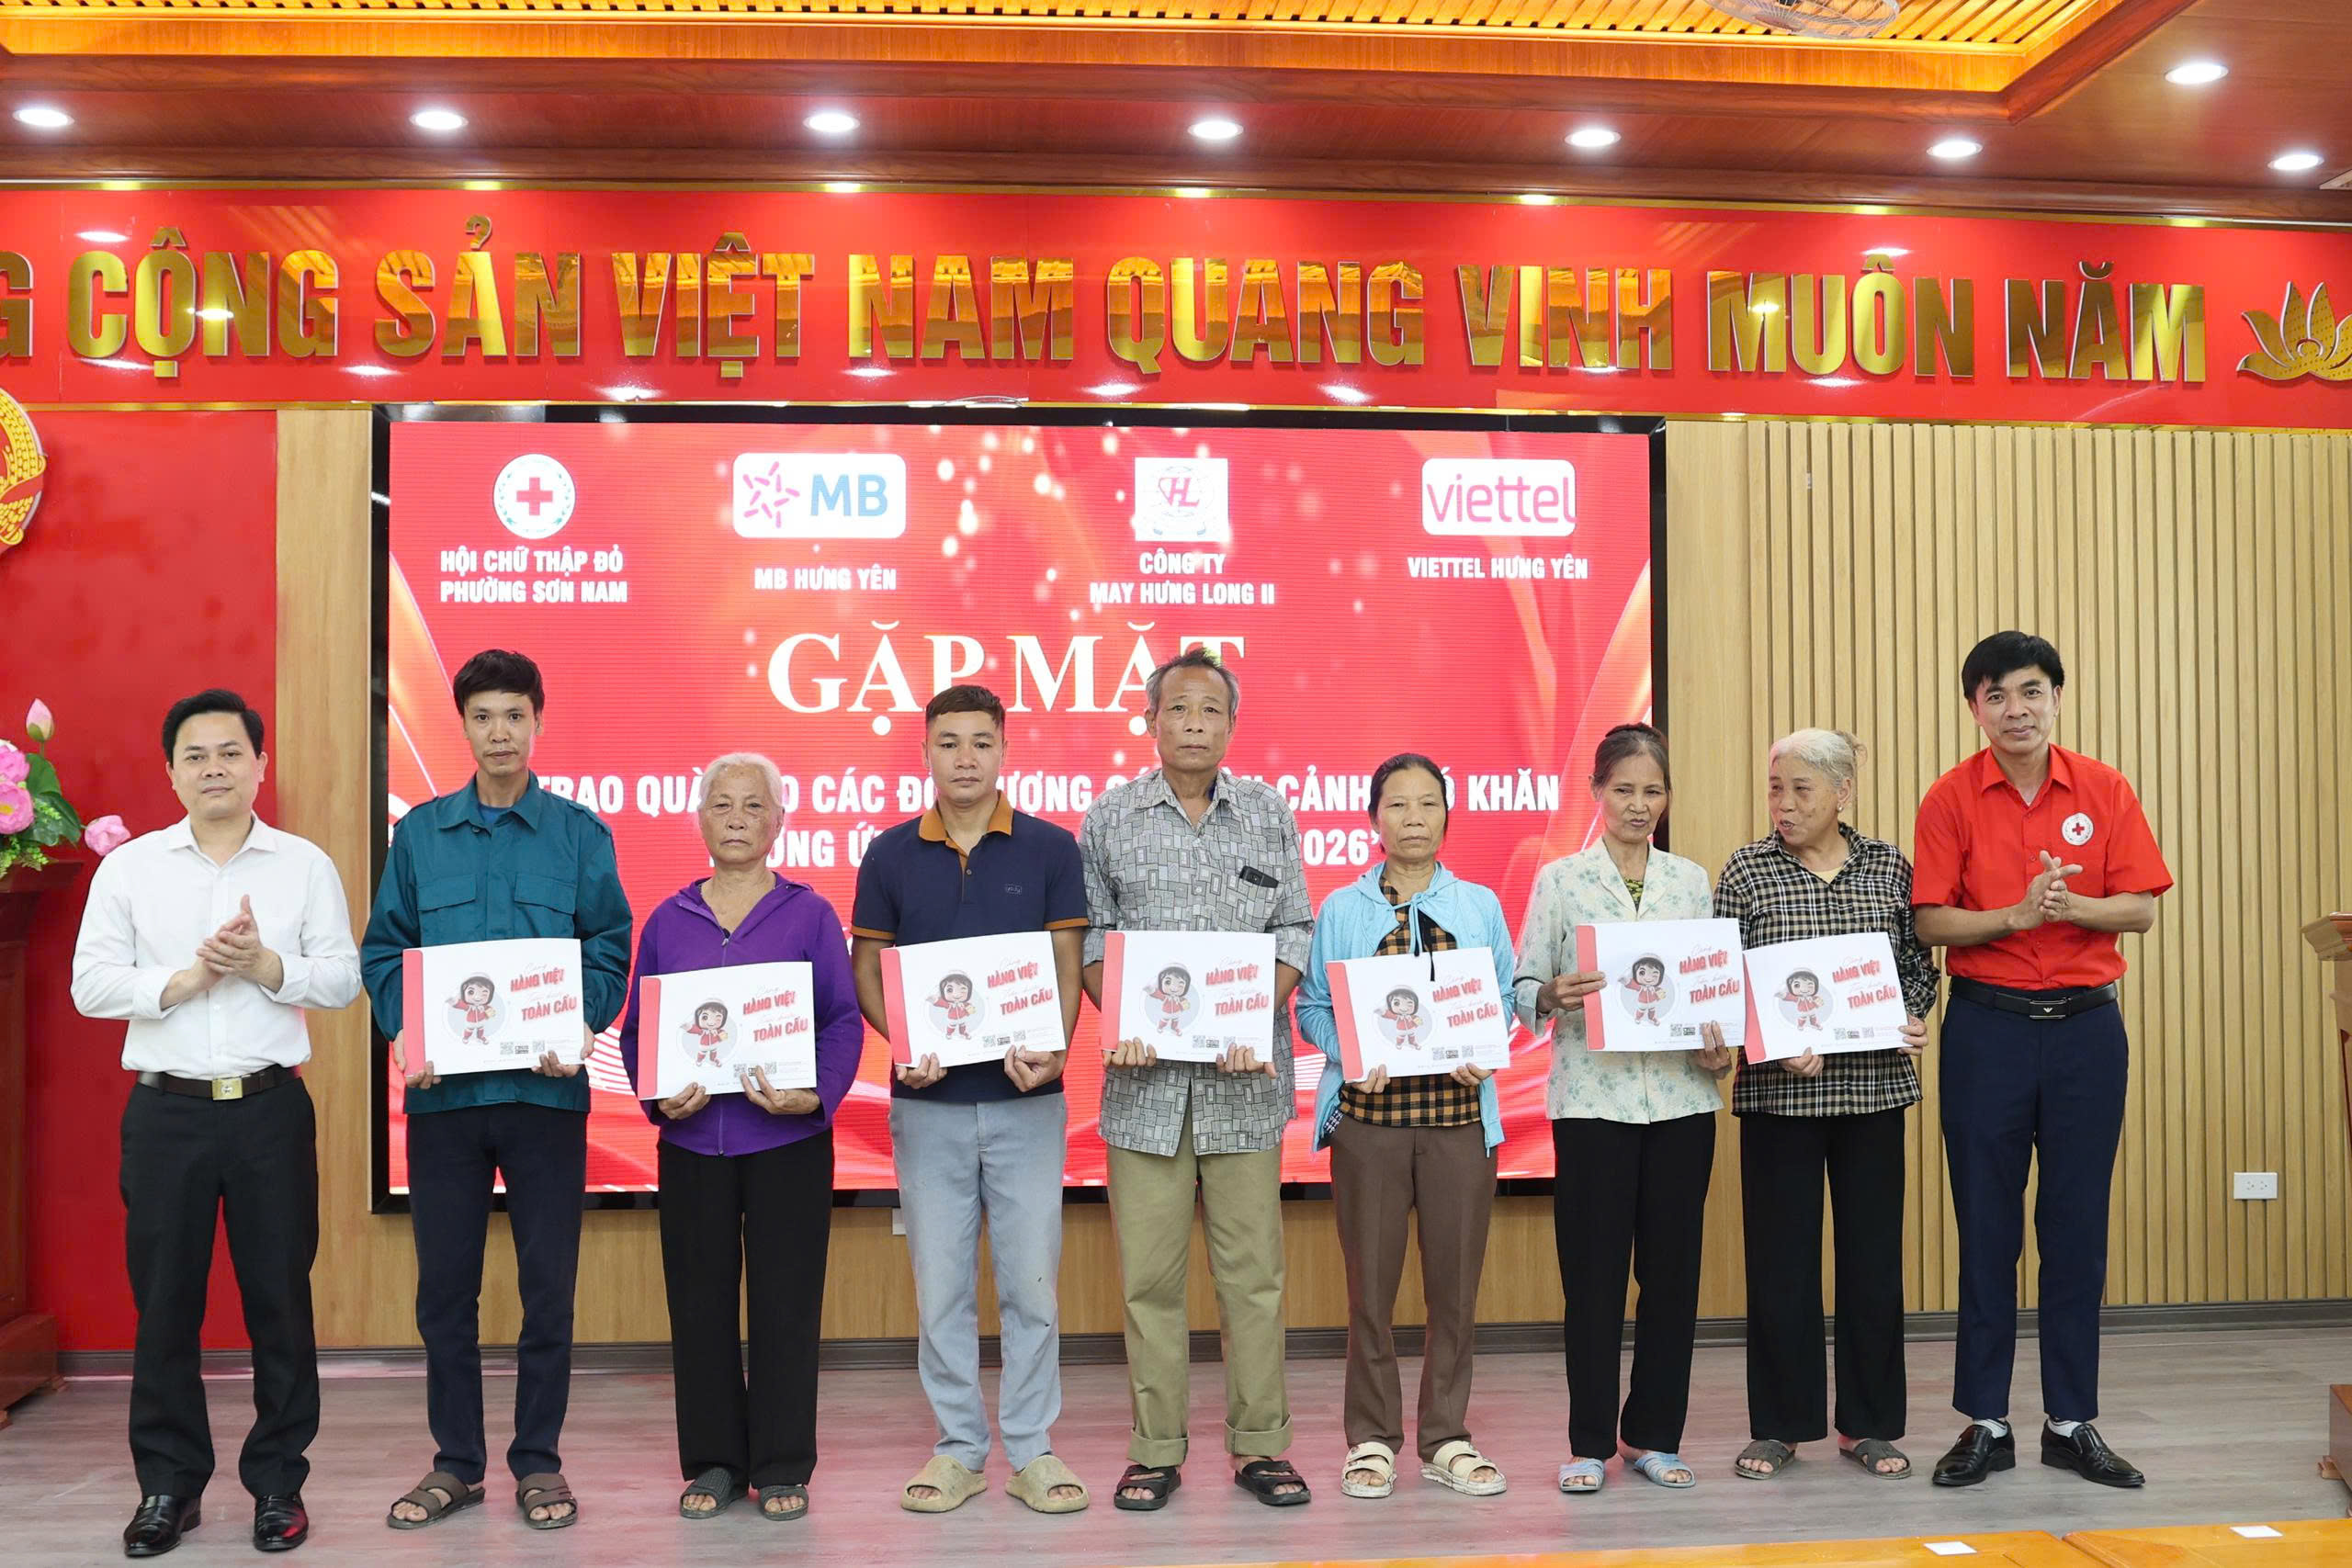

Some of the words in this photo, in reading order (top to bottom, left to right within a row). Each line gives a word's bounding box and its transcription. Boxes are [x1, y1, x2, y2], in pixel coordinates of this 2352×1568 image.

[67, 227, 339, 378] CỘNG
[375, 215, 581, 358] SẢN
[612, 231, 815, 378] VIỆT
[849, 254, 1073, 359] NAM
[1107, 257, 1424, 373] QUANG
[1458, 264, 1672, 372] VINH
[1707, 254, 1973, 378] MUÔN
[2005, 262, 2205, 382] NĂM
[811, 474, 888, 516] MB
[1427, 473, 1577, 524] viettel
[441, 546, 477, 577] HỘI
[483, 546, 529, 572] CHỮ
[534, 546, 588, 577] THẬP
[594, 544, 624, 572] ĐỎ
[1139, 547, 1196, 574] CÔNG
[1202, 553, 1227, 574] TY
[1407, 557, 1486, 579] VIETTEL
[1491, 555, 1545, 579] HƯNG
[1550, 553, 1589, 580] YÊN
[440, 576, 526, 603] PHƯỜNG
[532, 578, 574, 603] SƠN
[581, 581, 628, 603] NAM
[754, 568, 788, 591] MB
[794, 565, 852, 591] HƯNG
[857, 563, 897, 591] YÊN
[1090, 582, 1135, 604] MAY
[1140, 580, 1196, 604] HƯNG
[1202, 582, 1255, 604] LONG
[768, 621, 985, 736] GẶP
[811, 767, 885, 813] CÁC
[1275, 765, 1372, 812] CẢNH
[1468, 768, 1559, 811] KHĂN
[1000, 997, 1028, 1015] TOÀN
[1690, 983, 1716, 1003] TOÀN
[1847, 991, 1874, 1010] TOÀN
[522, 1002, 550, 1021] TOÀN
[1215, 998, 1243, 1016] TOÀN
[1447, 1010, 1475, 1028] TOÀN
[753, 1025, 782, 1043] TOÀN
